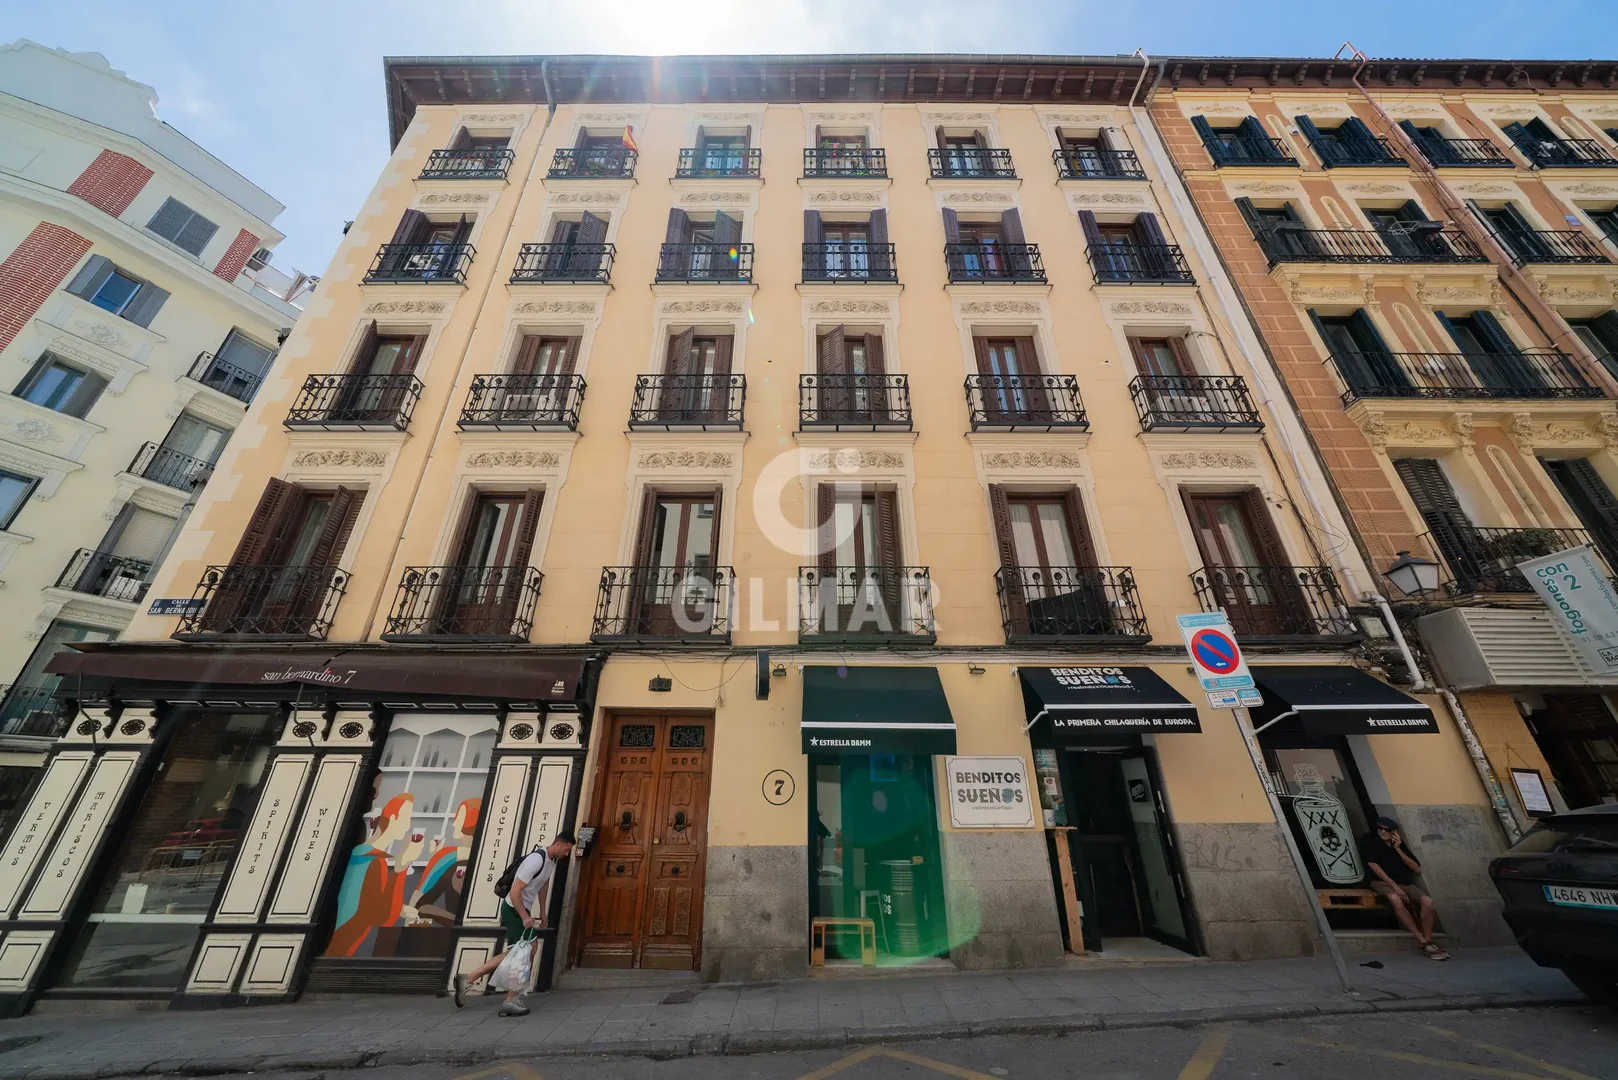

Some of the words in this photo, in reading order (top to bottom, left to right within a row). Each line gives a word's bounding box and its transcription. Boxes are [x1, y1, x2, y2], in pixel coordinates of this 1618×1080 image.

[1536, 562, 1570, 578] con
[1563, 574, 1582, 591] 2
[1542, 578, 1588, 635] fogones
[261, 671, 282, 681] san
[281, 666, 342, 684] bernardino
[344, 669, 357, 684] 7
[1050, 667, 1124, 676] BENDITOS
[1054, 719, 1065, 727] LA
[1067, 718, 1101, 727] PRIMERA
[1104, 716, 1151, 726] CHILAQUERÍA
[1153, 718, 1163, 726] DE
[1376, 718, 1408, 726] ESTRELLA
[1407, 718, 1430, 726] DAMM
[819, 739, 850, 747] ESTRELLA
[850, 739, 872, 747] DAMM
[955, 771, 1021, 784] BENDITOS
[774, 779, 785, 796] 7
[1302, 809, 1346, 831] XXX
[56, 791, 106, 878] MARISCOS
[248, 798, 281, 874] SPIRITS
[304, 808, 329, 861] WINES
[486, 795, 510, 882] COCTAILS
[538, 812, 549, 849] TAP
[1554, 888, 1587, 903] 4646
